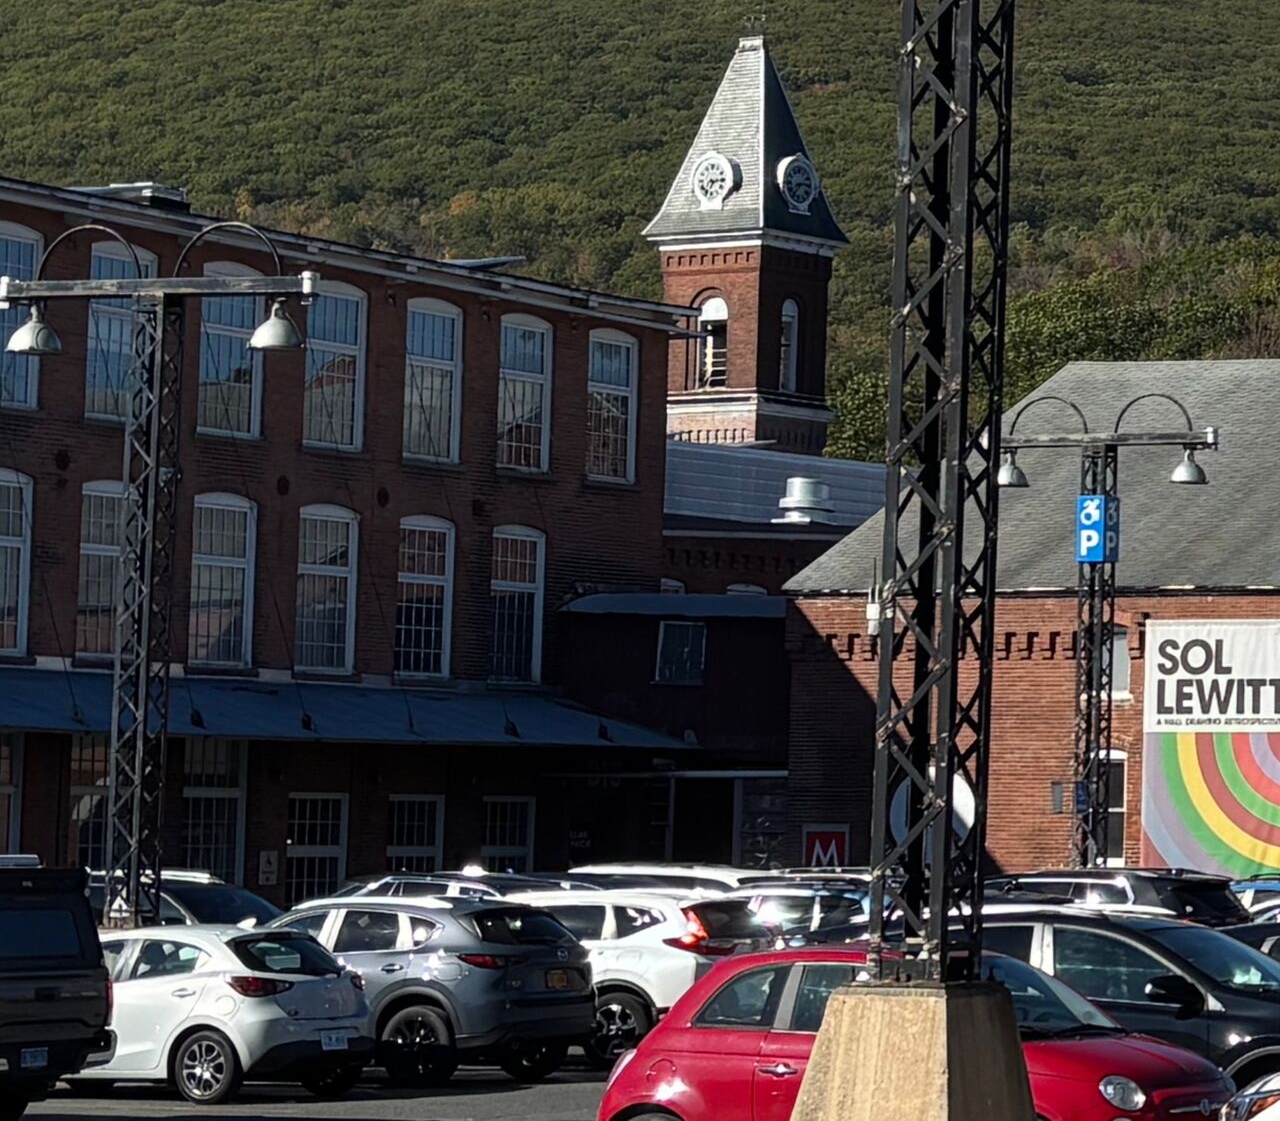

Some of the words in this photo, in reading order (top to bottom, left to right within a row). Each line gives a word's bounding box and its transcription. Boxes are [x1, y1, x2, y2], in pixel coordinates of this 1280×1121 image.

[1080, 529, 1099, 557] P
[1157, 638, 1233, 675] SOL
[811, 837, 840, 867] M
